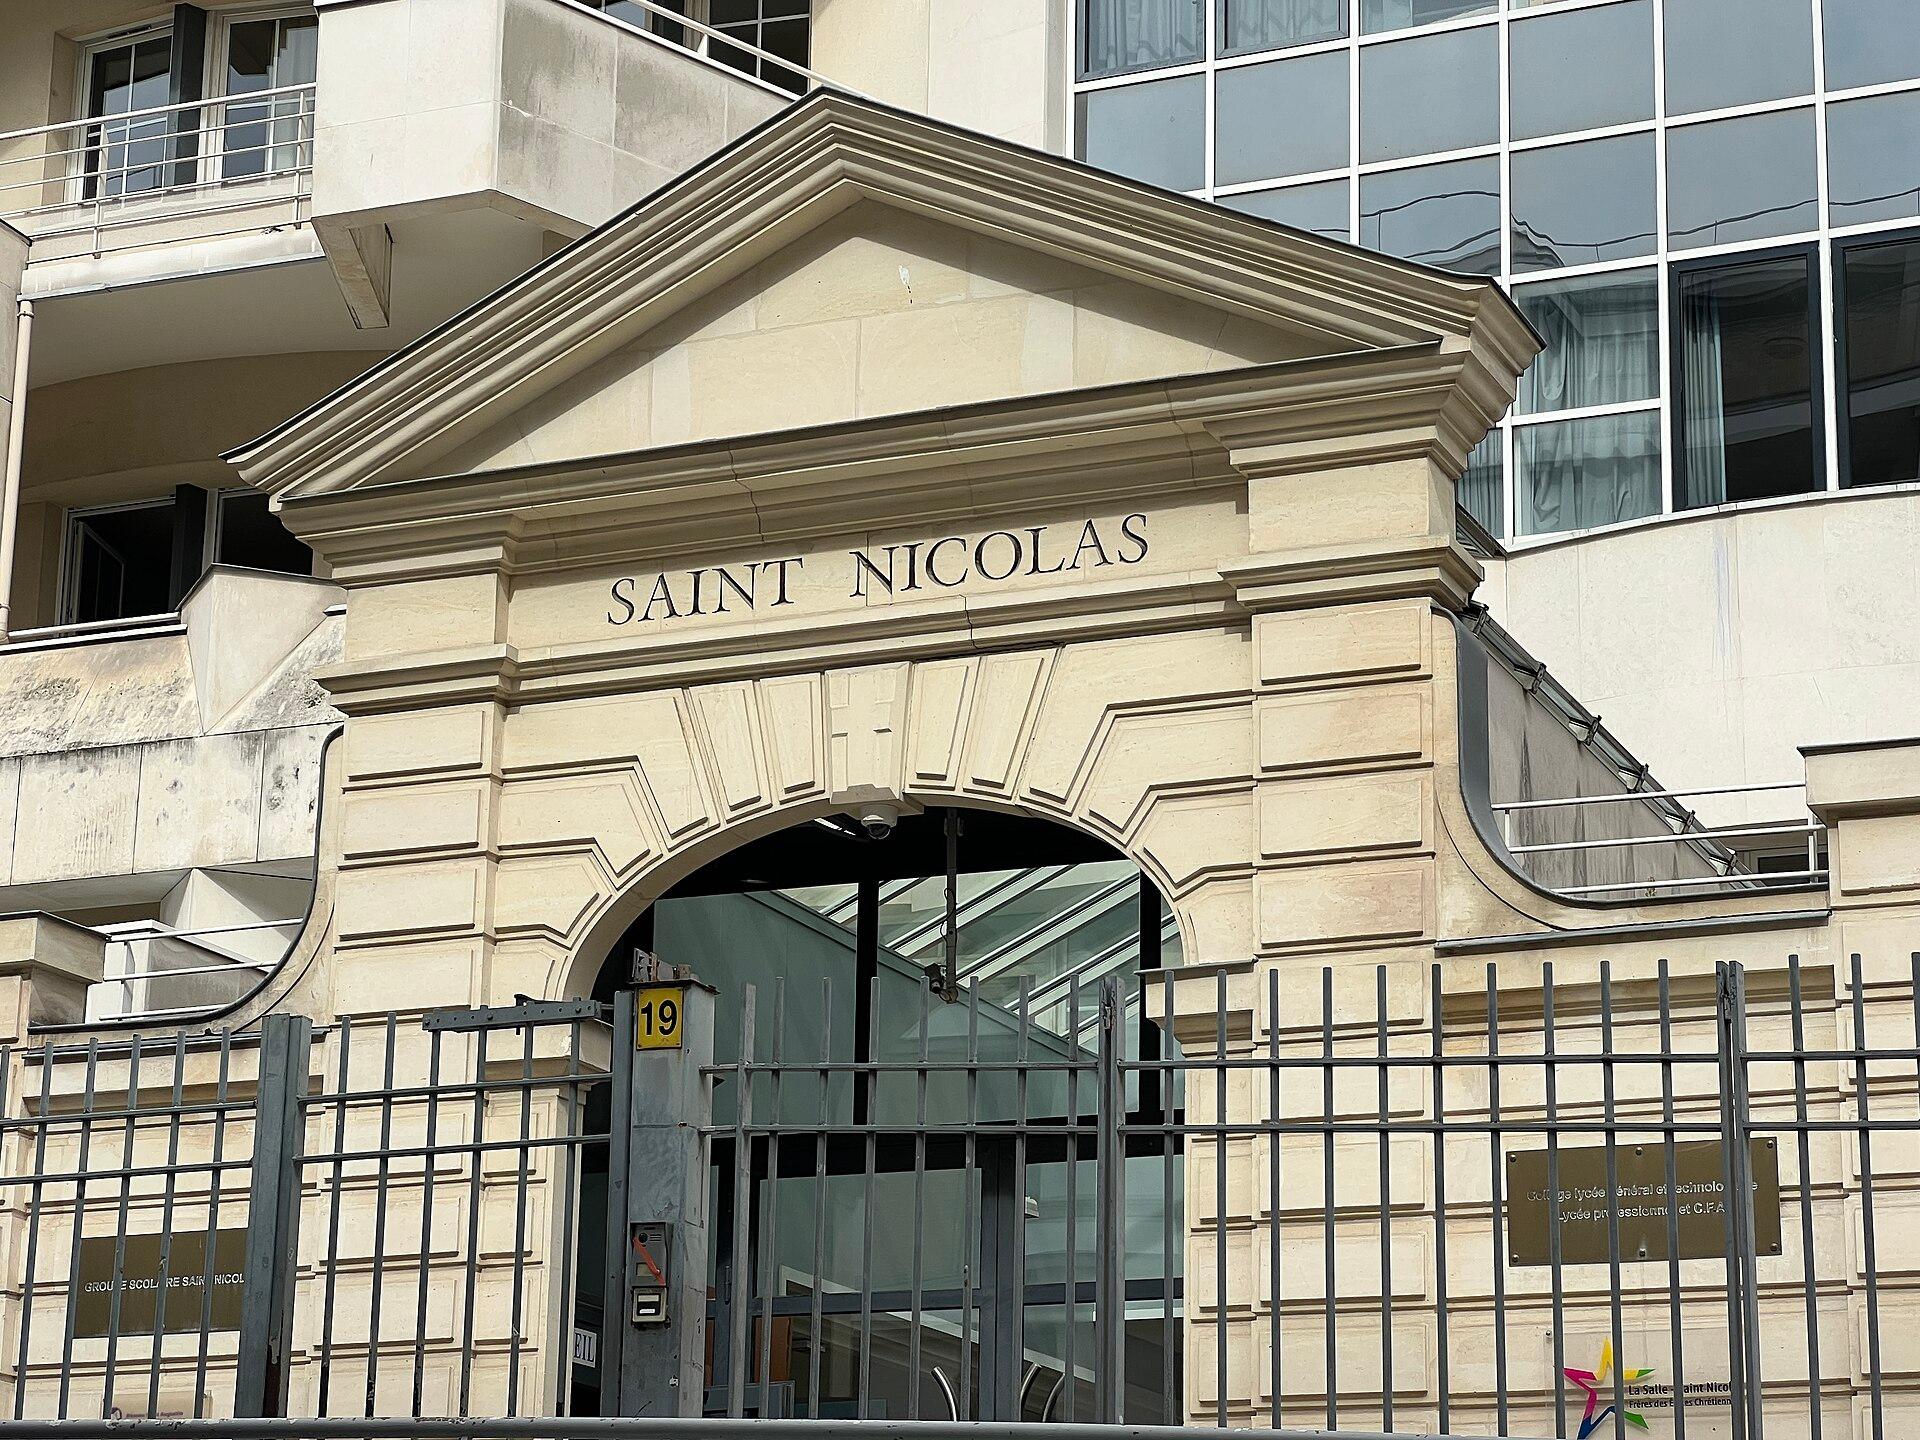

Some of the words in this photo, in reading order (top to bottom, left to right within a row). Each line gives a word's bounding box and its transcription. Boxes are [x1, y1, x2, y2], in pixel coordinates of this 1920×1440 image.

[607, 557, 803, 626] SAINT
[849, 513, 1147, 598] NICOLAS
[640, 999, 678, 1036] 19
[1526, 1187, 1572, 1203] Collge
[1574, 1186, 1606, 1202] lycée
[1614, 1184, 1653, 1197] énéral
[1673, 1180, 1759, 1194] echnoloe
[1593, 1205, 1669, 1222] pressionn
[1678, 1203, 1691, 1215] et
[84, 1279, 127, 1293] GROUE
[128, 1276, 180, 1291] SCOLRE
[182, 1275, 206, 1288] SAIN
[214, 1273, 245, 1286] NICOL
[1628, 1385, 1640, 1396] La
[1642, 1383, 1668, 1395] Salle
[1683, 1382, 1704, 1394] aint
[1628, 1399, 1653, 1409] Frères
[1653, 1399, 1668, 1408] des
[1694, 1396, 1732, 1407] Chrétienn
